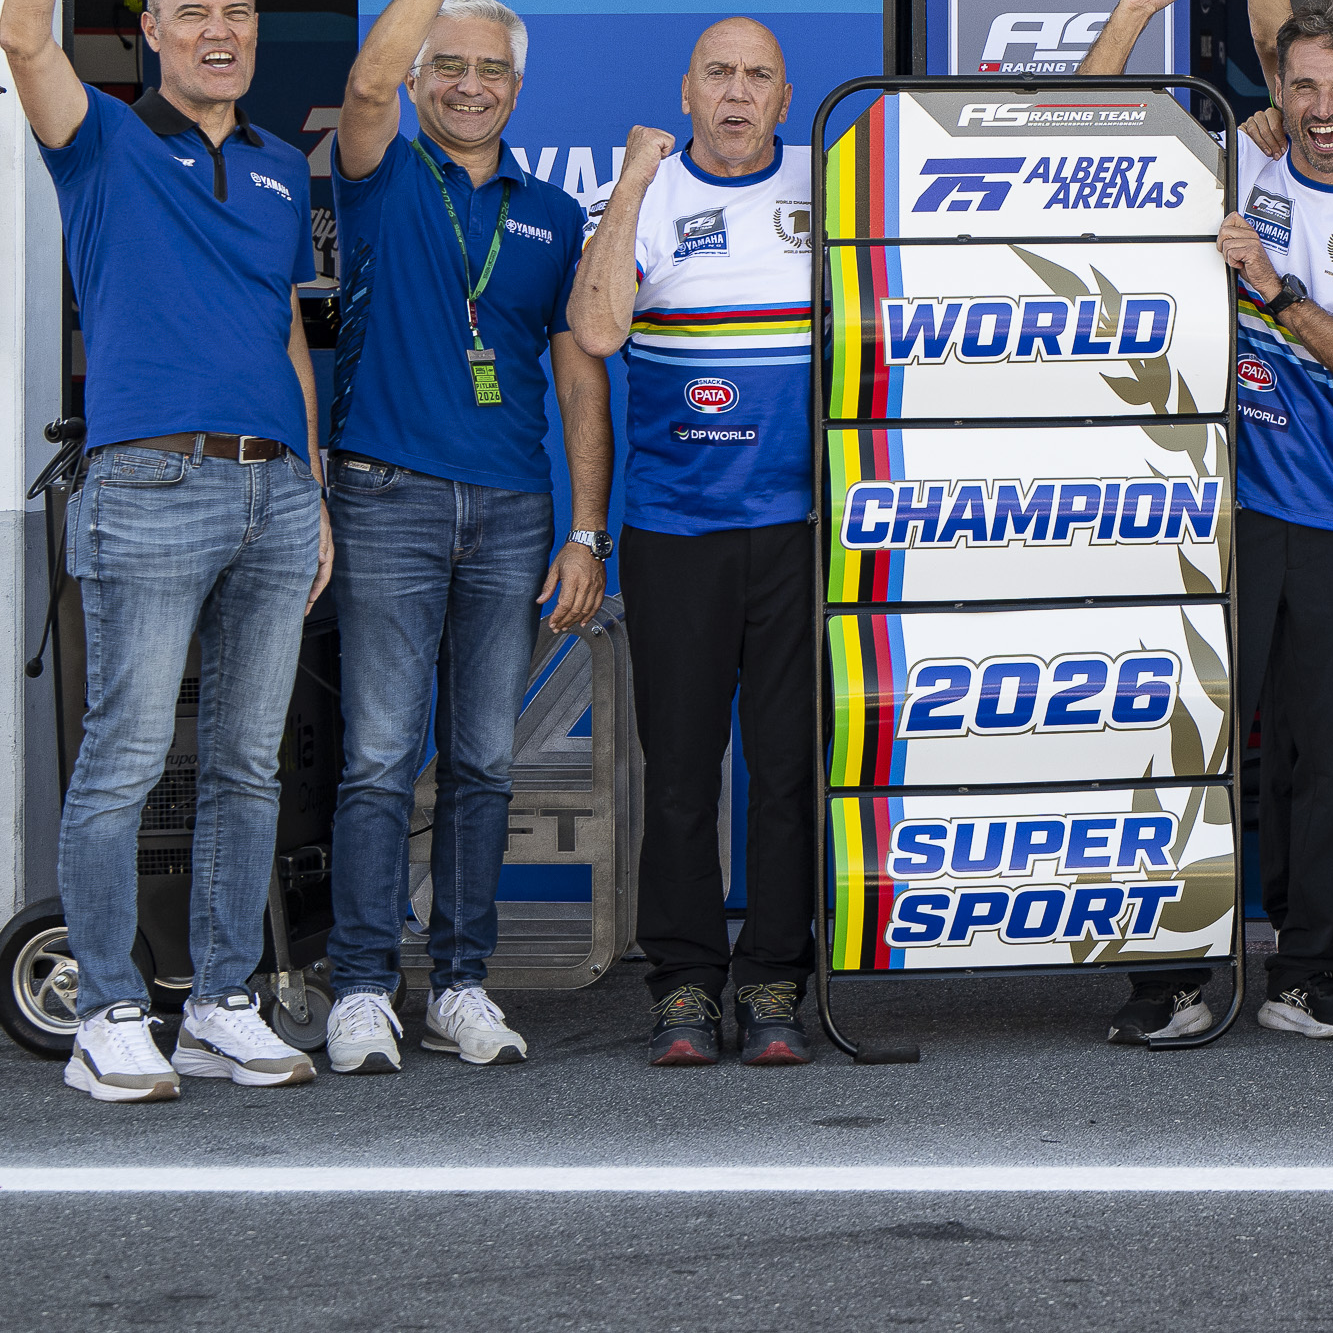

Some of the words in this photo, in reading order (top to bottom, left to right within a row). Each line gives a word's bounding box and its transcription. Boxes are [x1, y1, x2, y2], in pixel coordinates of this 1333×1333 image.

[1002, 62, 1067, 73] RACING
[957, 103, 1034, 127] AS
[1029, 111, 1092, 121] RACING
[1099, 111, 1146, 121] TEAM
[1023, 156, 1158, 184] ALBERT
[260, 175, 291, 197] YAMAHA
[1043, 180, 1189, 210] ARENAS
[516, 222, 553, 242] YAMAHA
[686, 234, 724, 251] YAMAHA
[1255, 220, 1289, 243] YAMAHA
[884, 297, 1174, 364] WORLD
[1240, 362, 1268, 381] PATA
[478, 391, 500, 401] 2026
[694, 389, 726, 402] PATA
[1242, 406, 1287, 426] WORLD
[690, 430, 706, 440] DP
[708, 430, 756, 441] WORLD
[845, 479, 1220, 546] CHAMPION
[900, 655, 1178, 737] 2026
[888, 812, 1176, 879] SUPER
[886, 882, 1180, 947] SPORT
